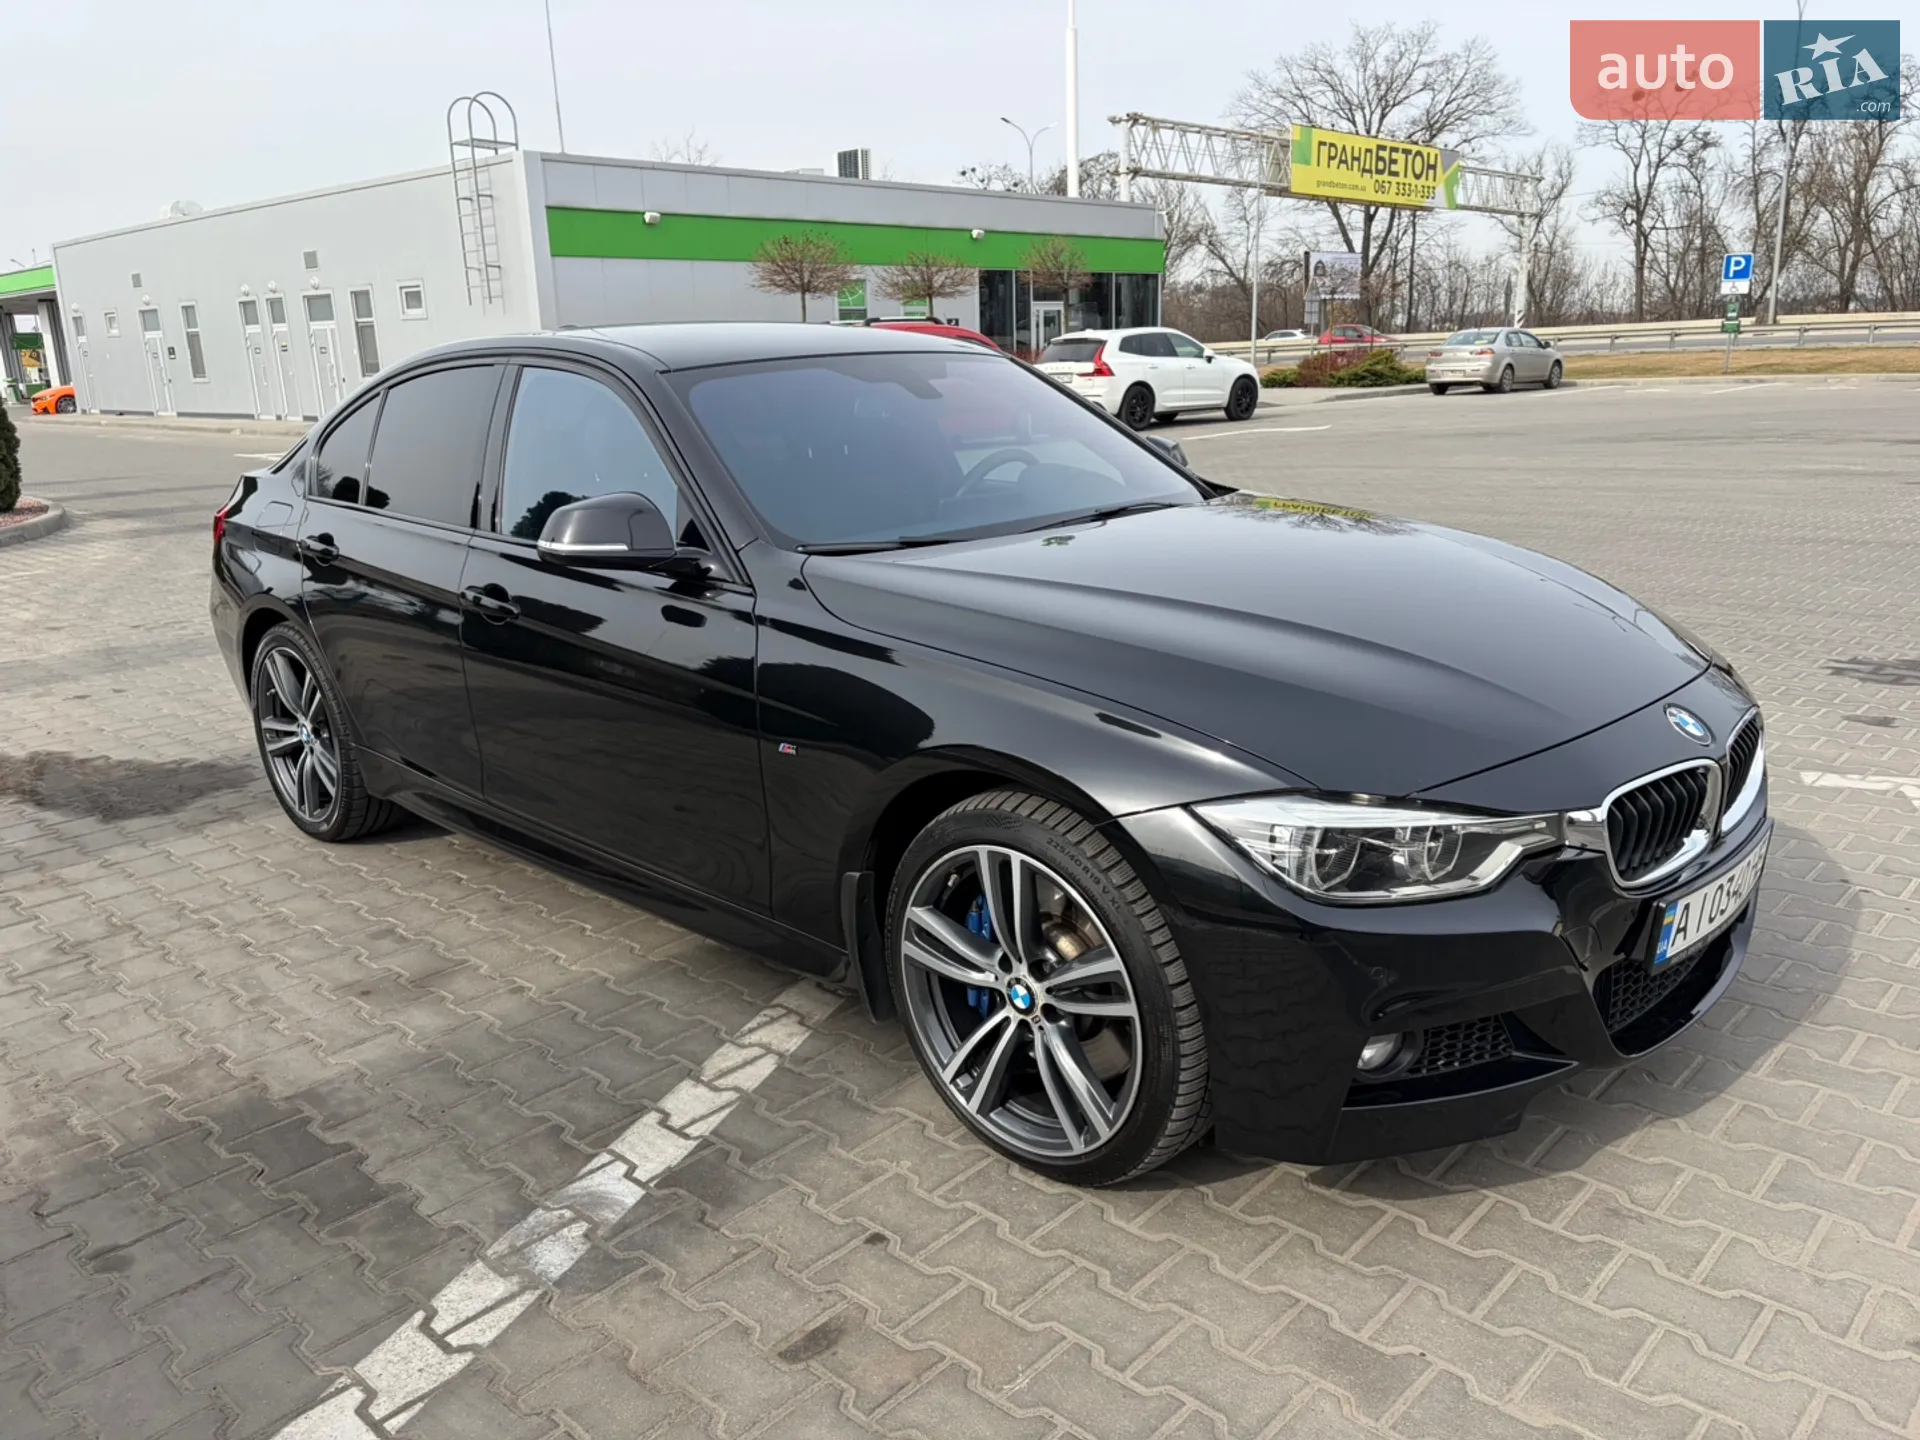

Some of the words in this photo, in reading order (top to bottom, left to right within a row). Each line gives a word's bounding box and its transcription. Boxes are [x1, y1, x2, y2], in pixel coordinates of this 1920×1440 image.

[1316, 140, 1439, 182] ГРАНДБЕТОН
[1373, 179, 1393, 196] 067
[1728, 256, 1746, 278] P
